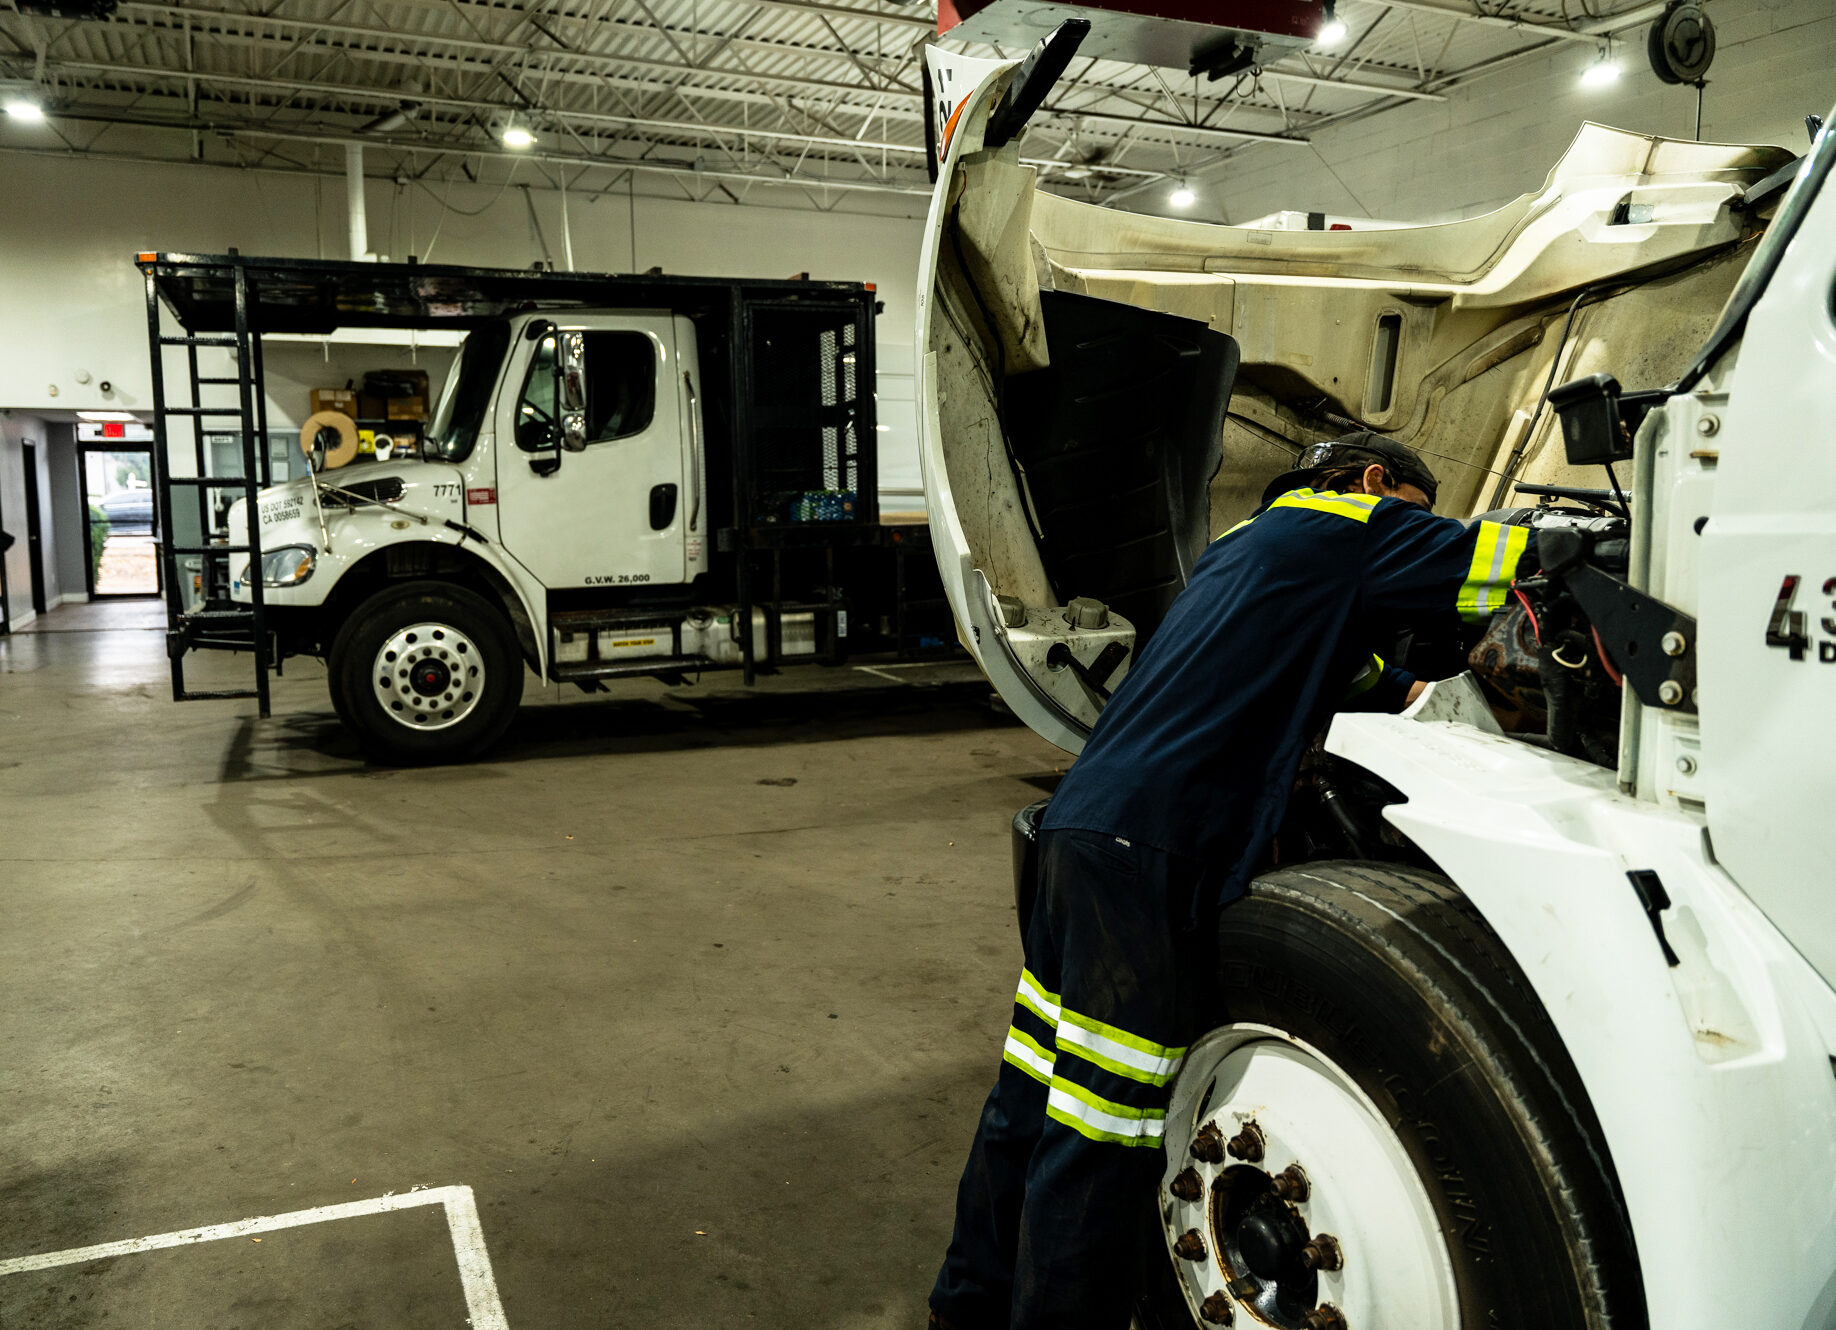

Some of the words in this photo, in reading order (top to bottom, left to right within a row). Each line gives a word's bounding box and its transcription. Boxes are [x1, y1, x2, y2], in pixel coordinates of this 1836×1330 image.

[433, 484, 461, 497] 7771
[270, 501, 282, 511] DOT
[263, 515, 272, 525] CA
[585, 576, 615, 585] G.V.W.
[618, 574, 650, 584] 26,000
